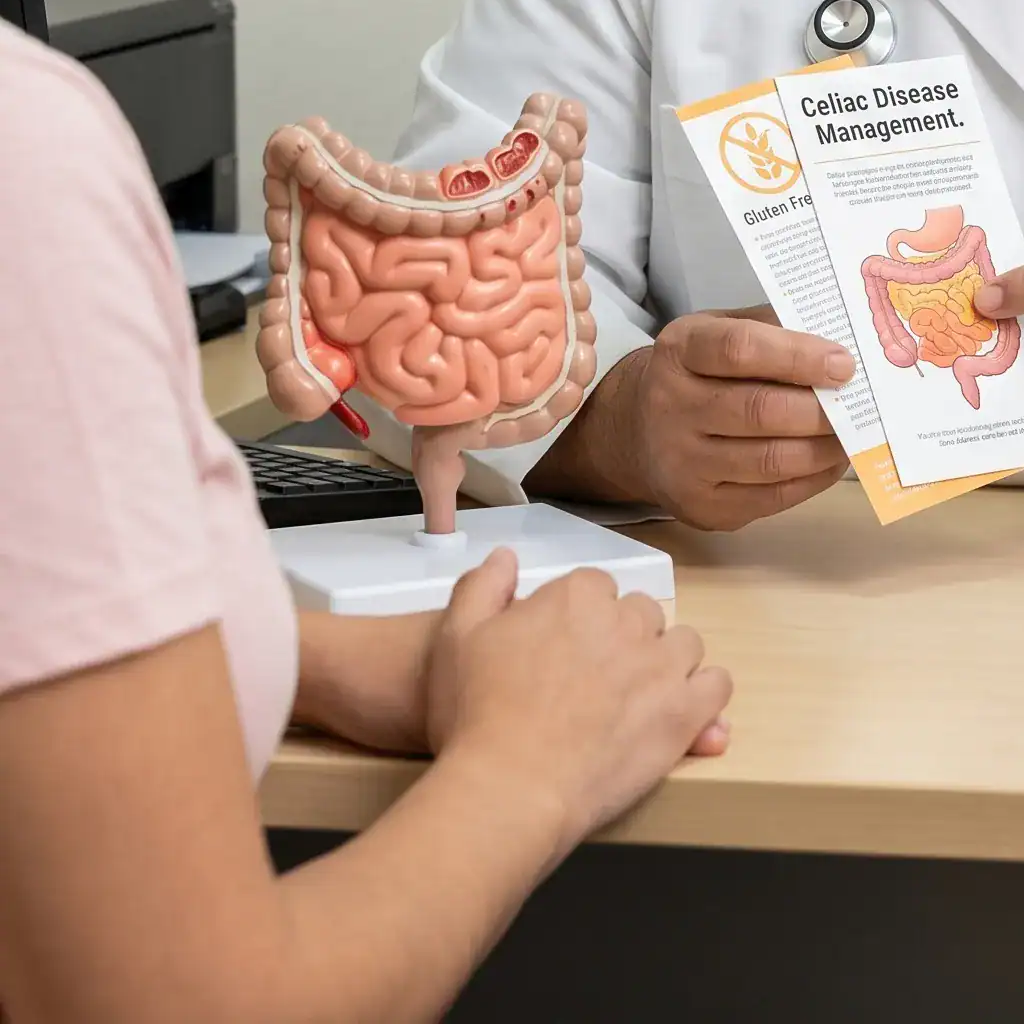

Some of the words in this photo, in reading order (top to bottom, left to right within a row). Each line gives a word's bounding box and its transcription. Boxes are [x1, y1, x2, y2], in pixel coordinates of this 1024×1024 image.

[800, 92, 869, 118] Celiac
[872, 82, 960, 109] Disease
[814, 108, 965, 145] Management.
[743, 201, 789, 226] Gluten
